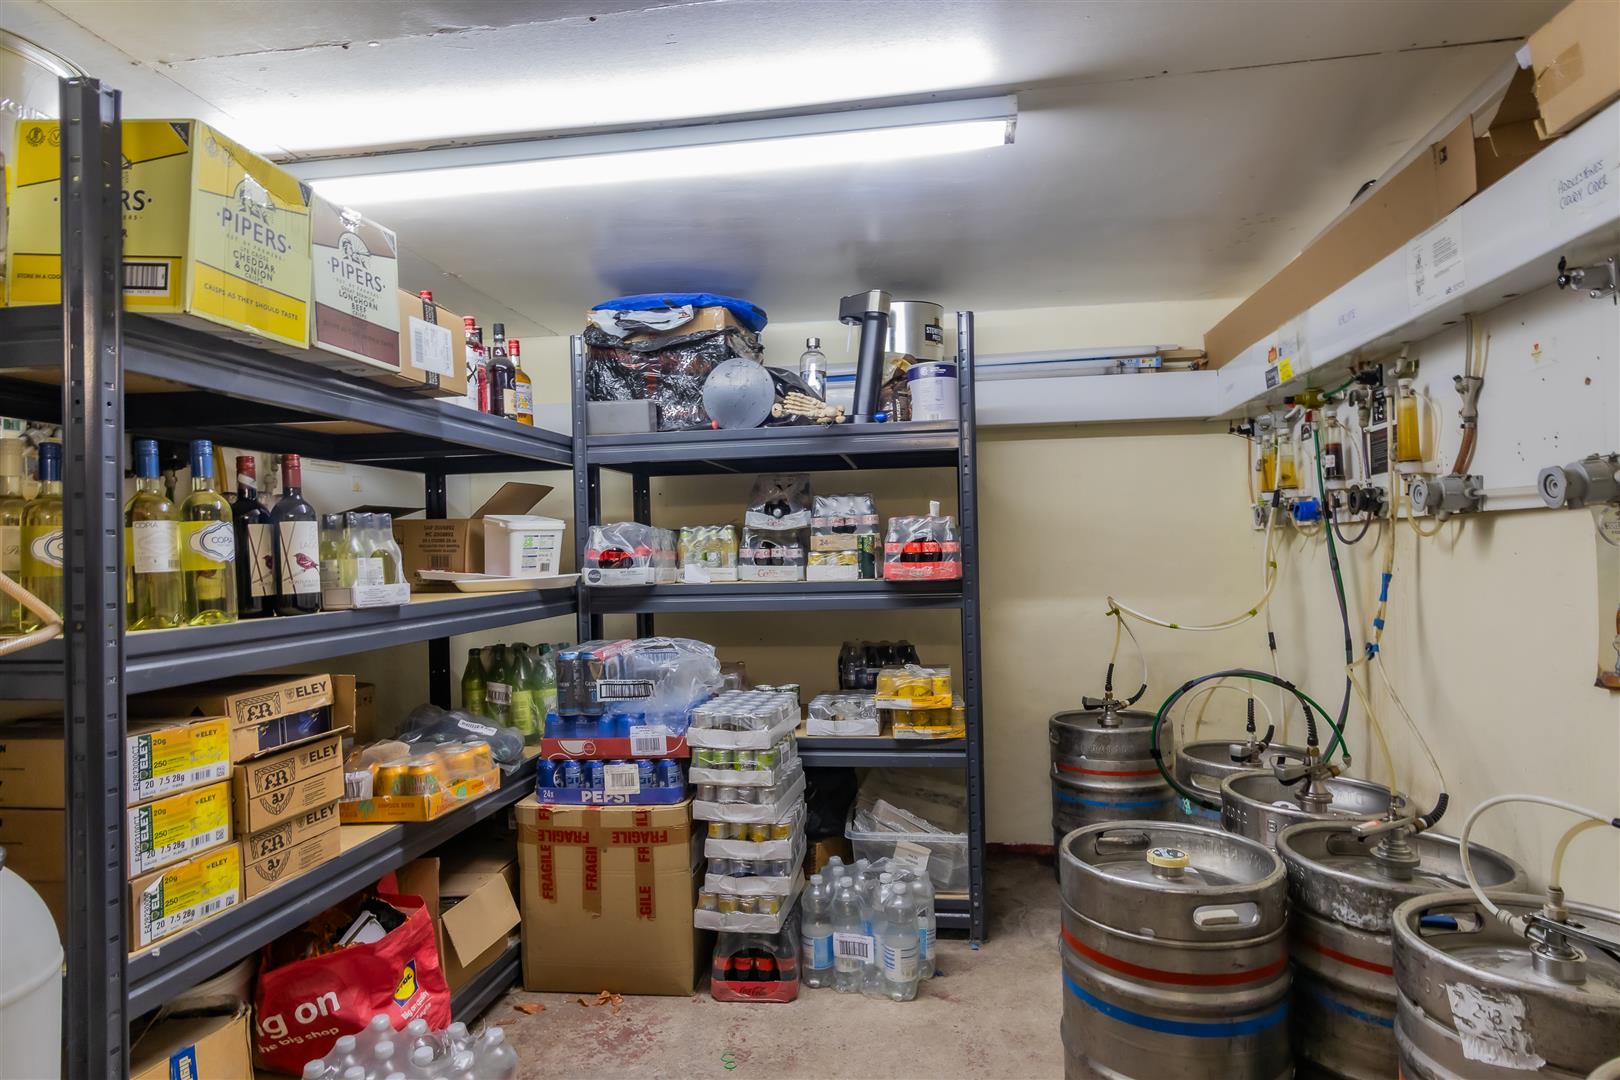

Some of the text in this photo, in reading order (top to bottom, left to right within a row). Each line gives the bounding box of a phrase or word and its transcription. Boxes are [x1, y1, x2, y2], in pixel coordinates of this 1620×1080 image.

[222, 207, 286, 254] PIPERS
[233, 249, 276, 274] CHEDDAR
[47, 272, 62, 281] COO
[234, 260, 273, 282] & ONION
[331, 256, 383, 293] PIPERS
[203, 282, 299, 321] CRISPS AS THEY SHOULD TASTE
[338, 289, 378, 312] LONGHORN
[351, 302, 367, 313] BEEF
[134, 521, 159, 530] COPIA
[295, 681, 327, 698] ELEY
[153, 738, 167, 746] 20g
[200, 729, 217, 738] ELEY
[138, 737, 149, 770] ELEY
[308, 743, 338, 763] ELEY
[153, 760, 168, 769] 250
[145, 773, 185, 790] 20 7.5 28g
[199, 793, 216, 804] ELEY
[581, 790, 630, 803] PEPSI
[153, 808, 167, 817] 20g
[306, 803, 336, 826] ELEY
[139, 809, 149, 841] ELEY
[154, 830, 168, 840] 250
[537, 829, 590, 843] FRAGILE
[612, 830, 668, 844] FRAGILE
[146, 841, 185, 859] 20 7.5 28g
[211, 857, 228, 869] ELEY
[585, 846, 598, 891] FRAGI
[164, 875, 178, 885] 20g
[540, 844, 554, 900] FRAGILE
[165, 896, 179, 907] 250
[639, 886, 652, 916] GILE
[156, 908, 196, 930] 20 7.5 28g
[255, 991, 341, 1040] ig on
[280, 1035, 305, 1047] big
[305, 1026, 340, 1041] shop
